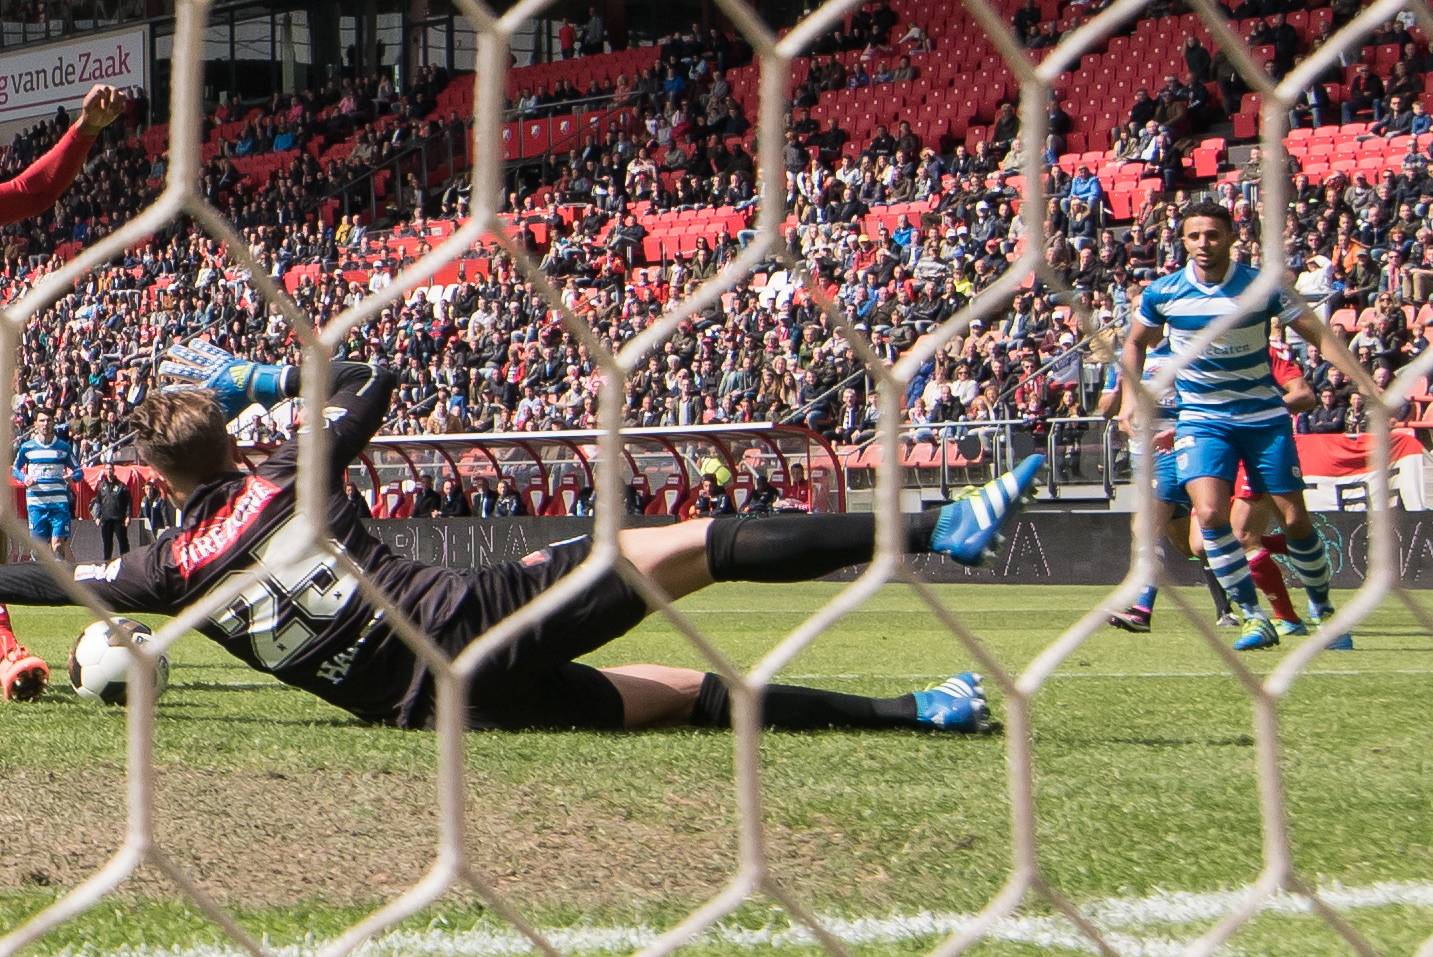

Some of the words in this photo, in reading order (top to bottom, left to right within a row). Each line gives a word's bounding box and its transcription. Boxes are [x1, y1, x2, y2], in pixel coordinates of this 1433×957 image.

[11, 68, 49, 94] van
[52, 56, 76, 87] de
[78, 44, 132, 83] Zaak
